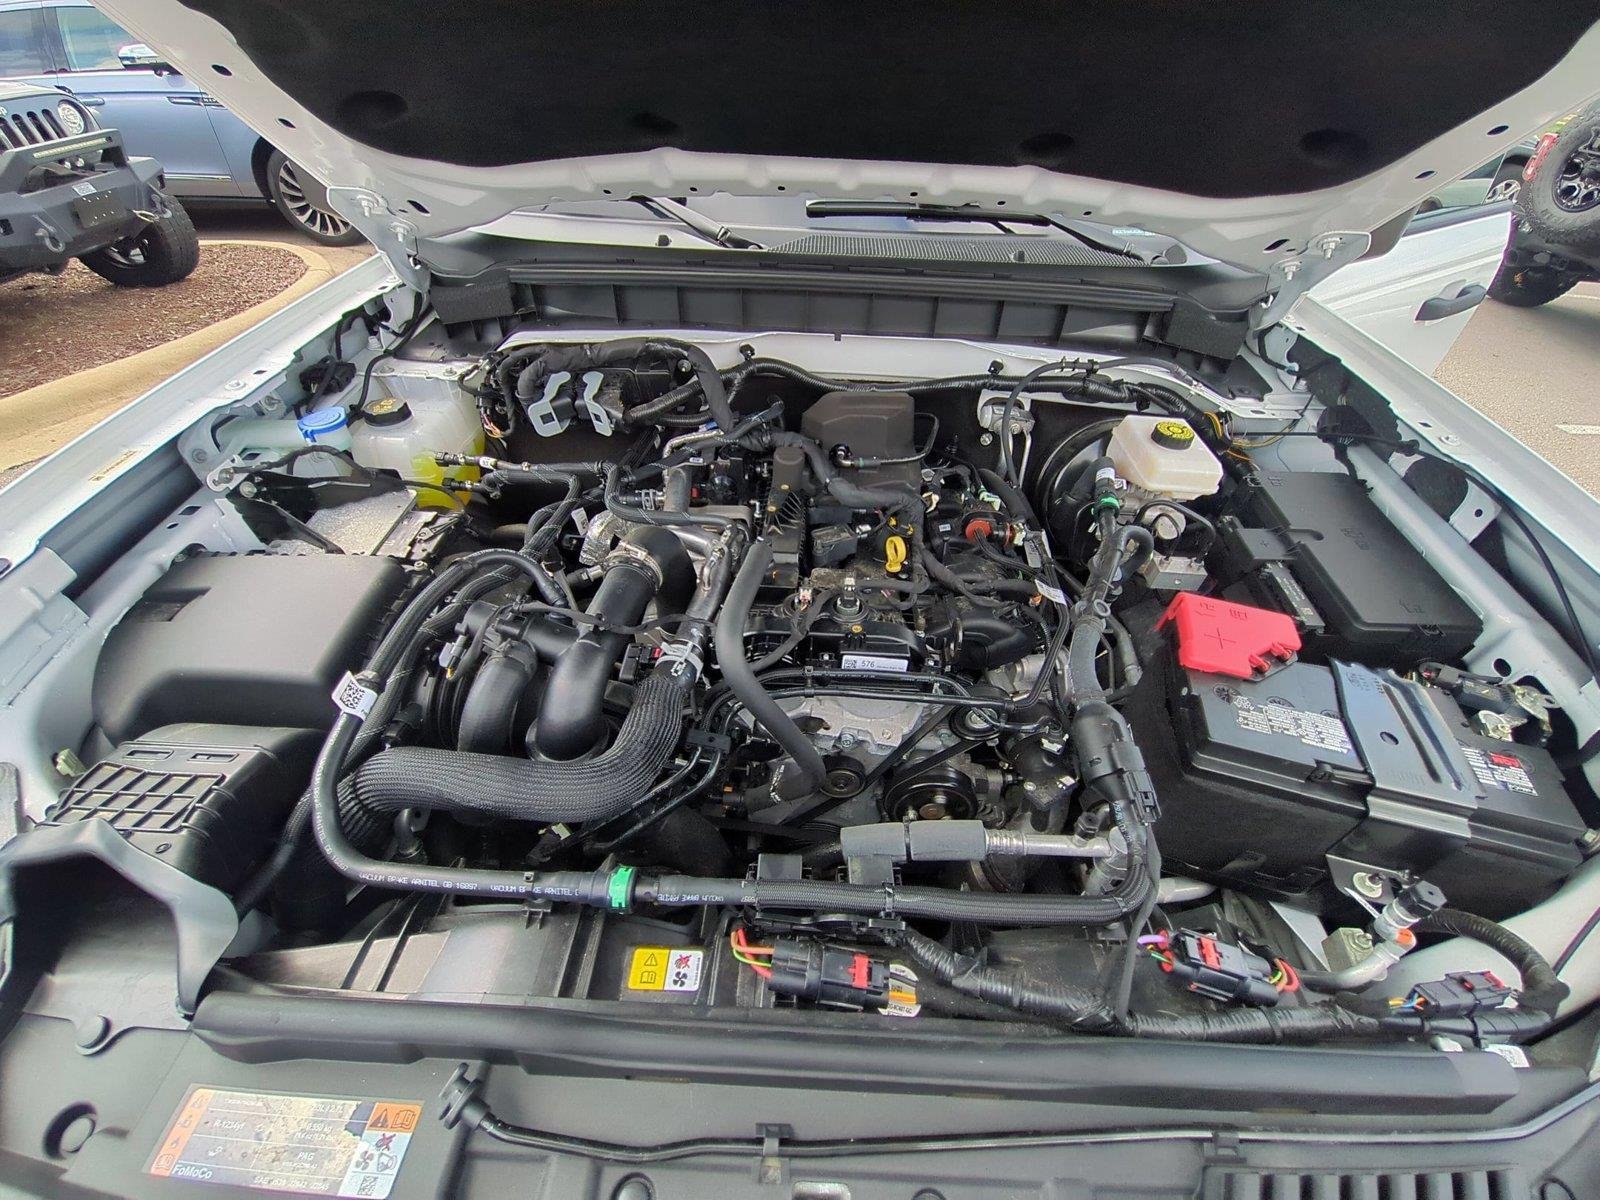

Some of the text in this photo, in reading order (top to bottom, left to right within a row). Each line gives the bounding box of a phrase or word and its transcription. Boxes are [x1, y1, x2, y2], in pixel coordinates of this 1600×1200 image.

[861, 660, 875, 668] 576
[359, 872, 385, 882] VACUUM
[388, 875, 408, 884] BRAKE
[411, 878, 440, 888] ARNITEL
[443, 880, 453, 889] GB
[490, 884, 517, 894] VACUUM
[545, 887, 573, 896] ARNITEL
[172, 1164, 213, 1180] FoMoCo
